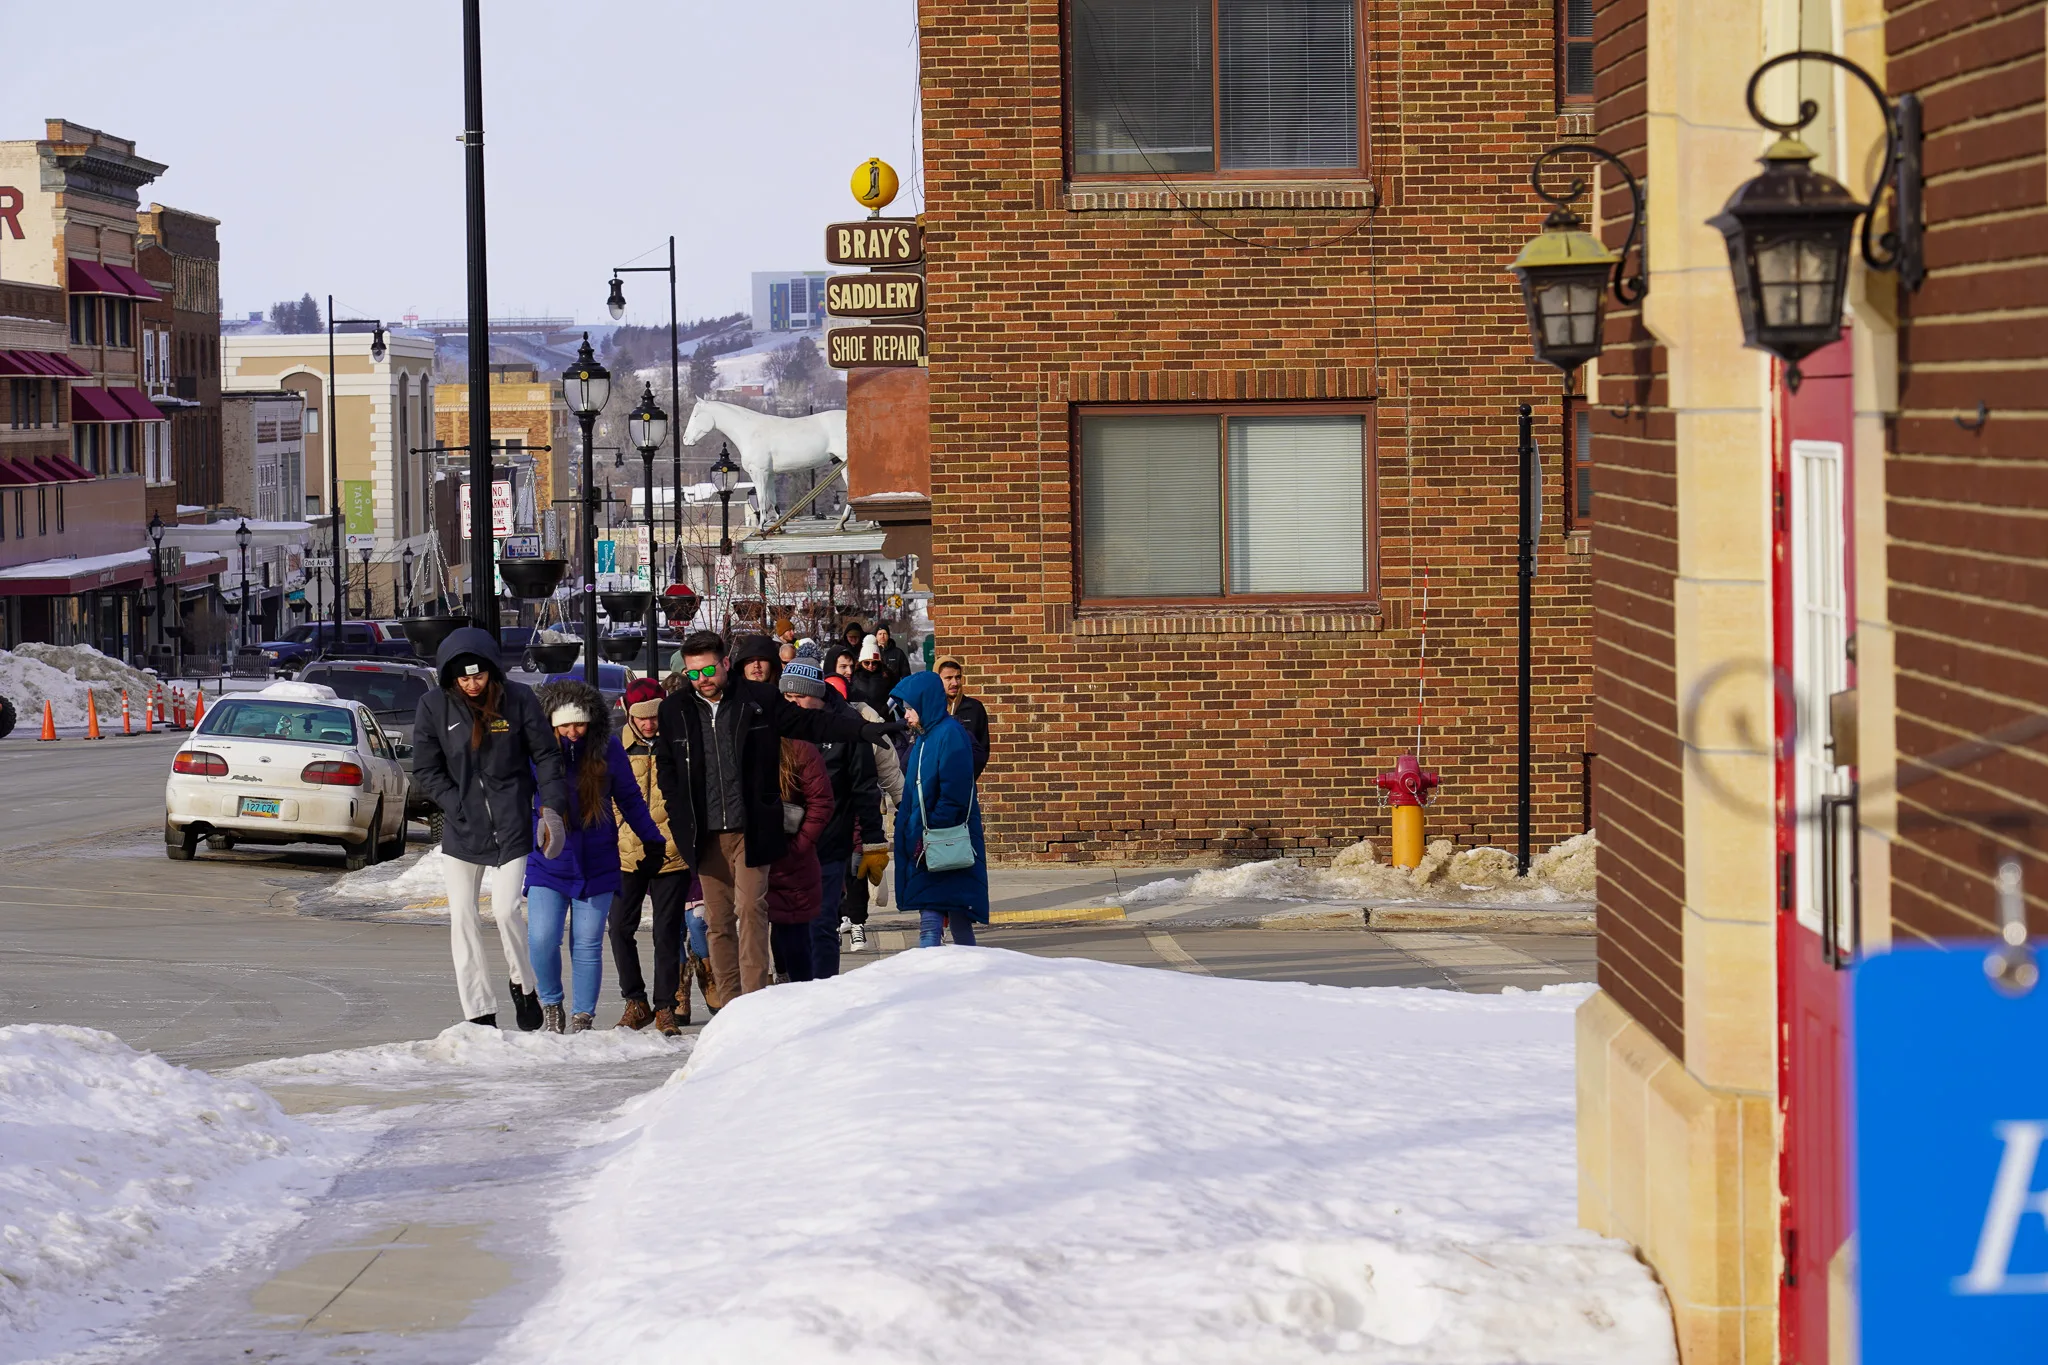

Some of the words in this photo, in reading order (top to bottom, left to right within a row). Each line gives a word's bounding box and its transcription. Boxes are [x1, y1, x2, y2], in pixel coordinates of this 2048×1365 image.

[0, 185, 26, 239] R
[838, 227, 910, 259] BRAY'S
[829, 283, 918, 310] SADDLERY
[832, 336, 867, 362] SHOE
[873, 335, 920, 361] REPAIR
[354, 485, 363, 518] TASTY
[492, 486, 503, 497] NO
[246, 803, 260, 812] 127
[261, 803, 276, 813] CZK
